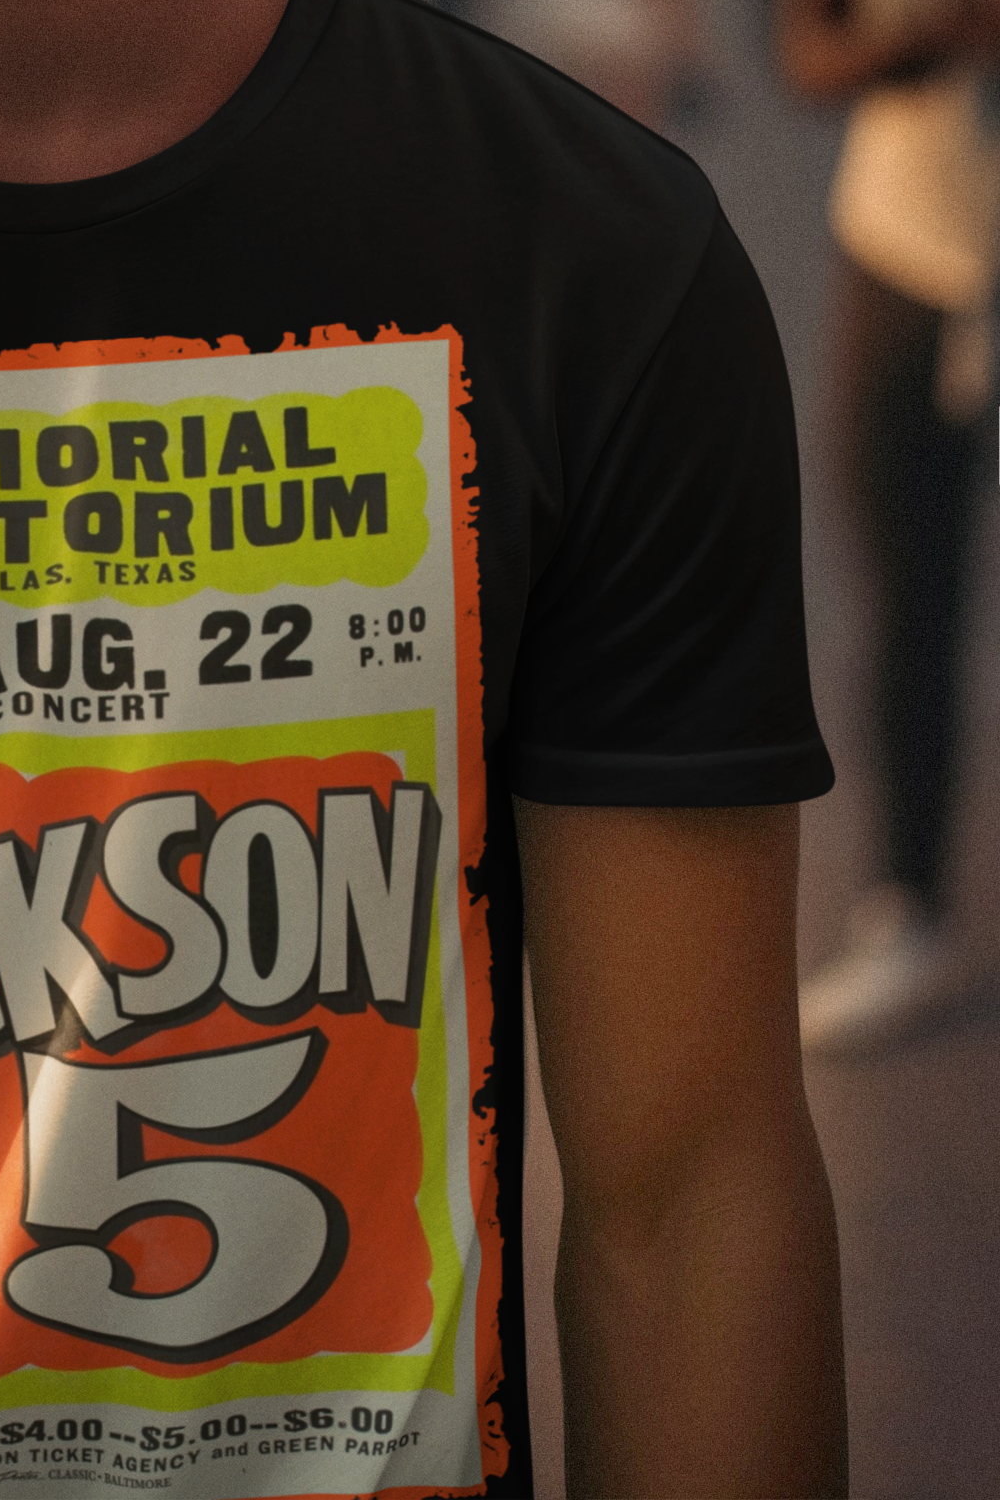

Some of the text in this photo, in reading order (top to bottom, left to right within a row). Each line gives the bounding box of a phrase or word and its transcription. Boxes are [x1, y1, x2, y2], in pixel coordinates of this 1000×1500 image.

[94, 560, 197, 586] TEXAS
[349, 606, 426, 640] 8:00
[198, 604, 314, 687] 22
[4, 1026, 350, 1365] 5
[30, 1448, 104, 1464] TICKET
[112, 1449, 201, 1473] AGENCY
[211, 1441, 249, 1460] and
[258, 1436, 335, 1456] GREEN
[345, 1432, 421, 1457] PARROT
